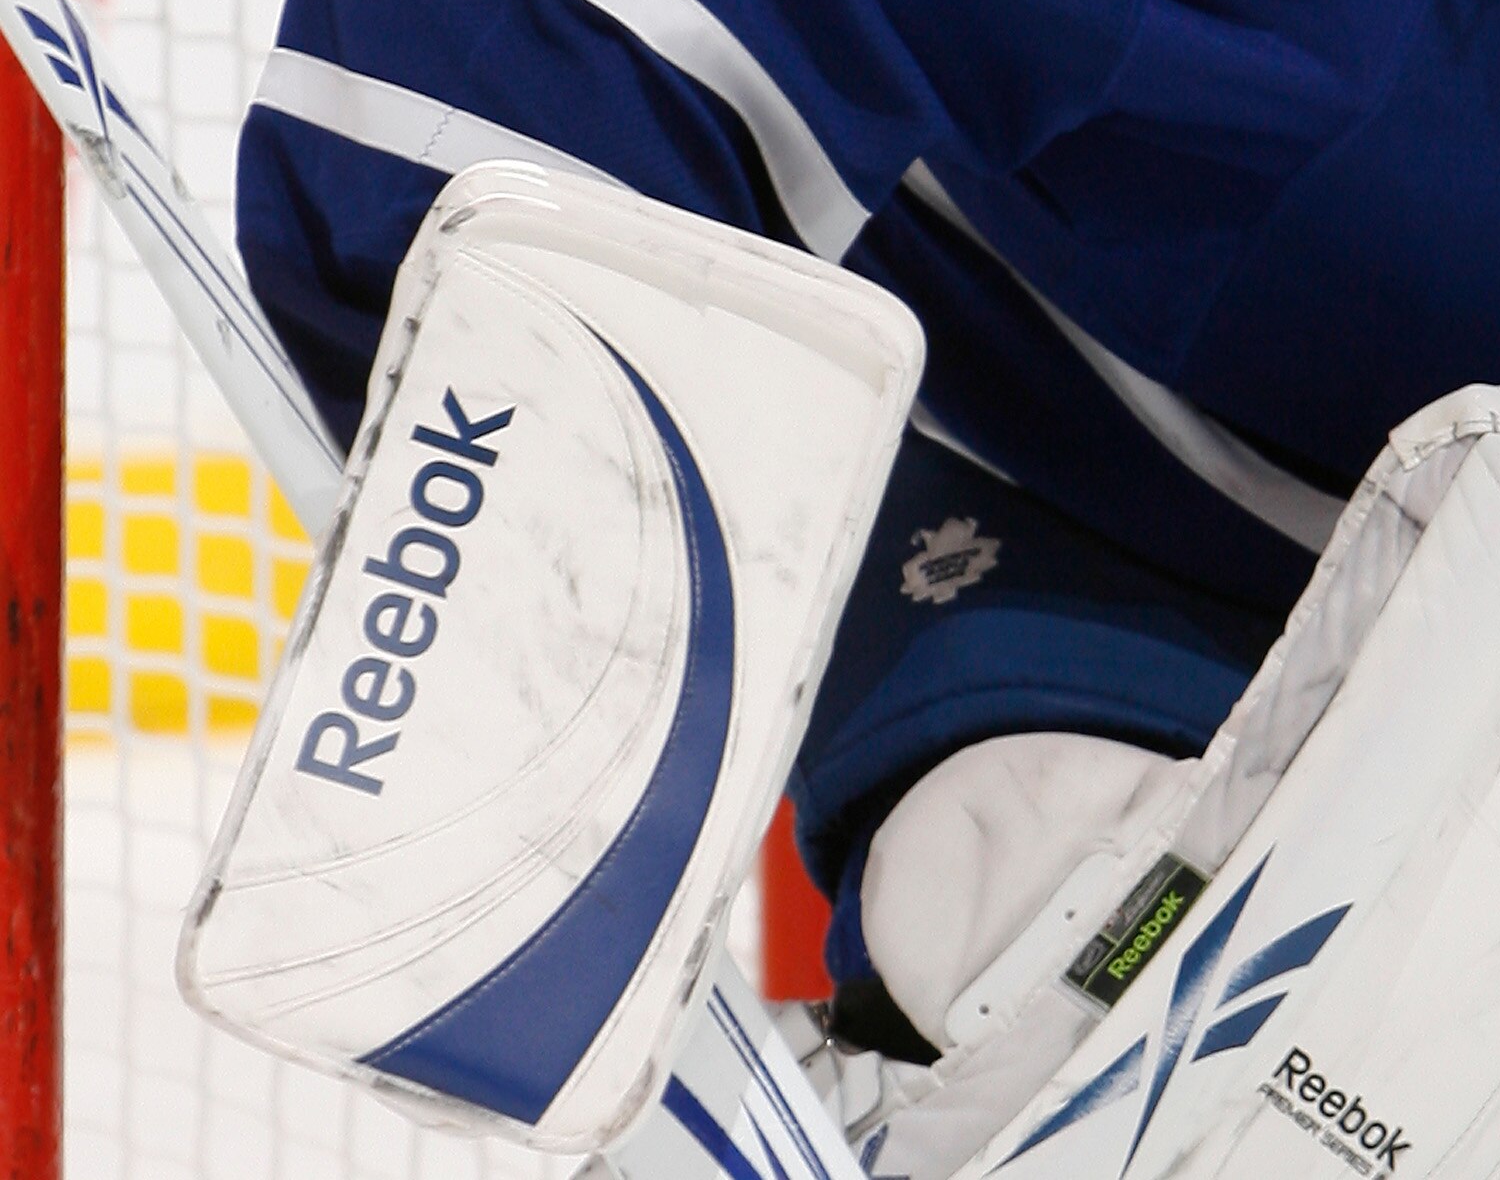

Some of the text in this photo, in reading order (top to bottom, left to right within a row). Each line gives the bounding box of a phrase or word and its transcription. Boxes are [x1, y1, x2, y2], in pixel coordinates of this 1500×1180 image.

[295, 384, 517, 797] Reebok
[1107, 891, 1185, 980] Reebok
[1272, 1046, 1412, 1172] Reebok
